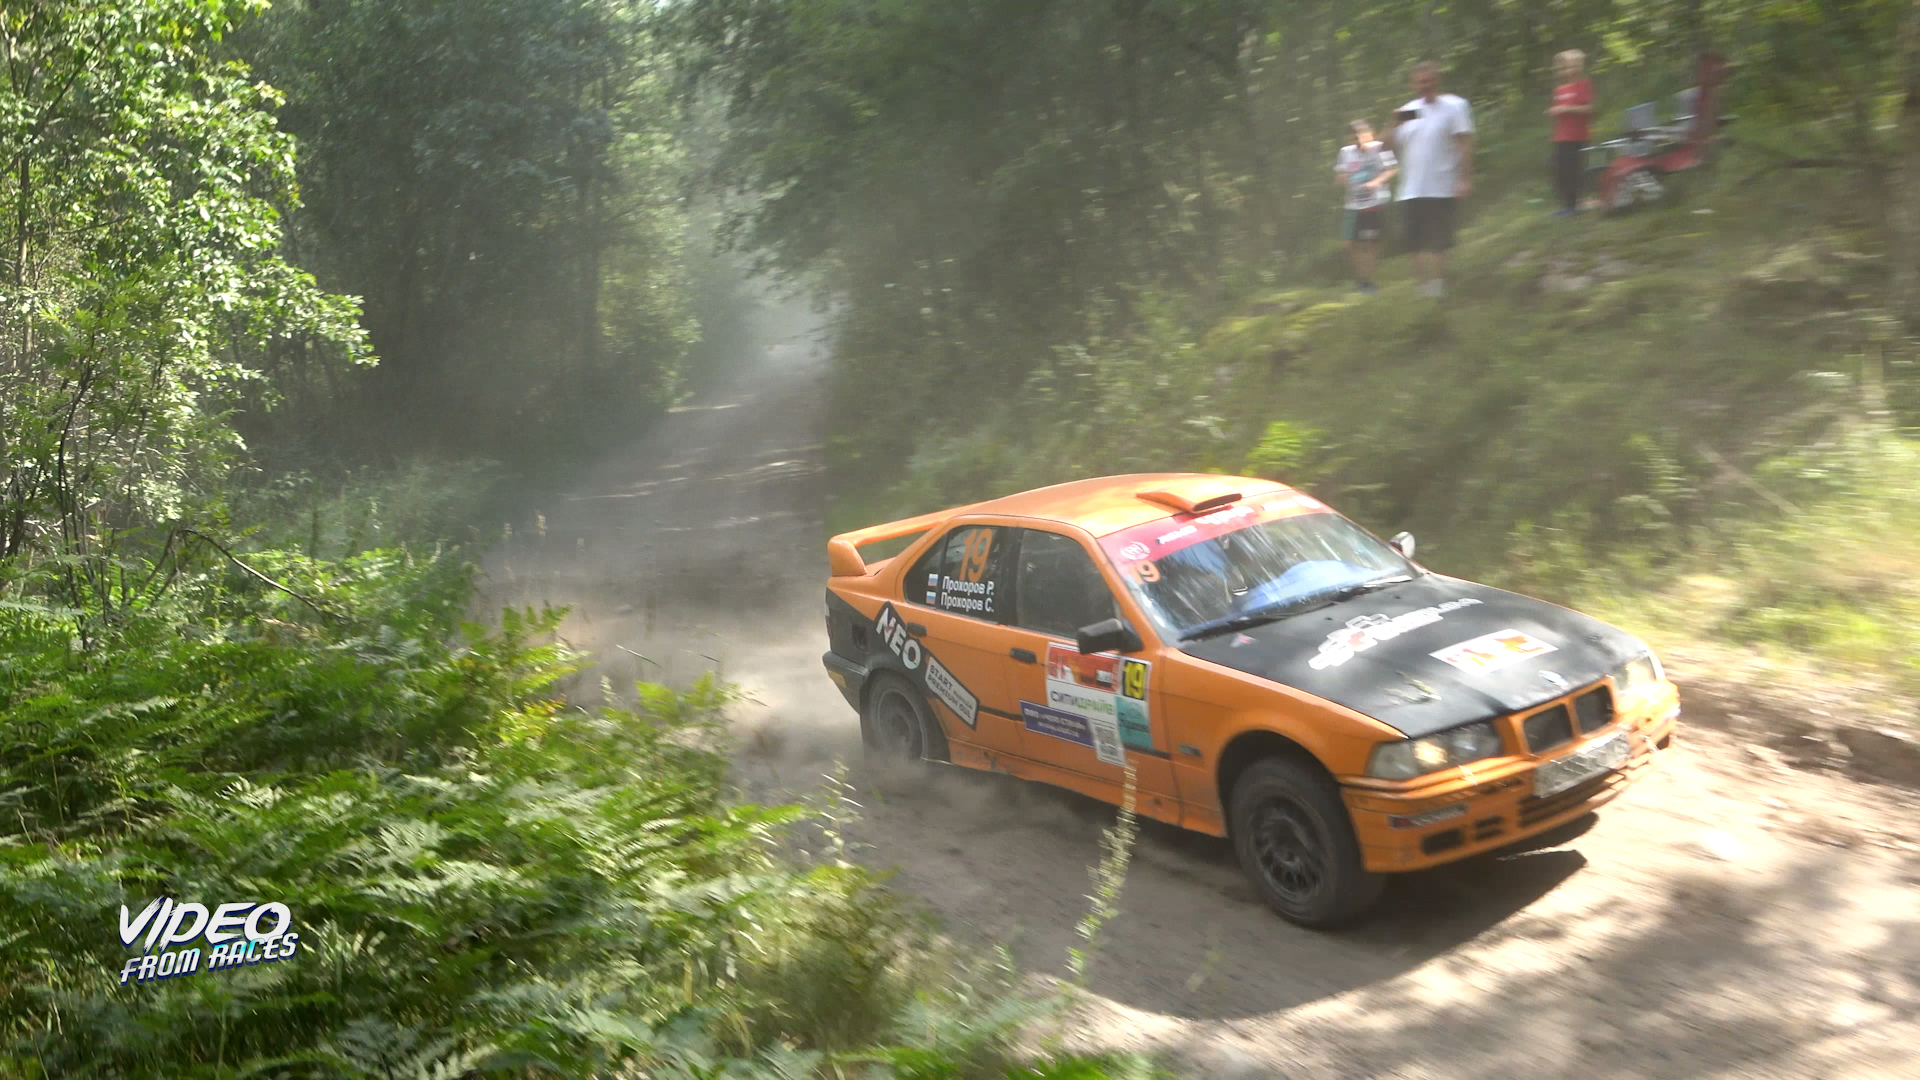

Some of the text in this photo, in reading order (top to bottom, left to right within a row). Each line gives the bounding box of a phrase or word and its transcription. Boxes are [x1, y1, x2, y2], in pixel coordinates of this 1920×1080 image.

[960, 528, 993, 583] 19
[1128, 560, 1161, 585] 19
[942, 576, 995, 596] Прохоров Р.
[940, 592, 995, 613] Прохоров С.
[876, 607, 921, 670] NEO
[930, 664, 953, 690] START
[1124, 661, 1146, 700] 19
